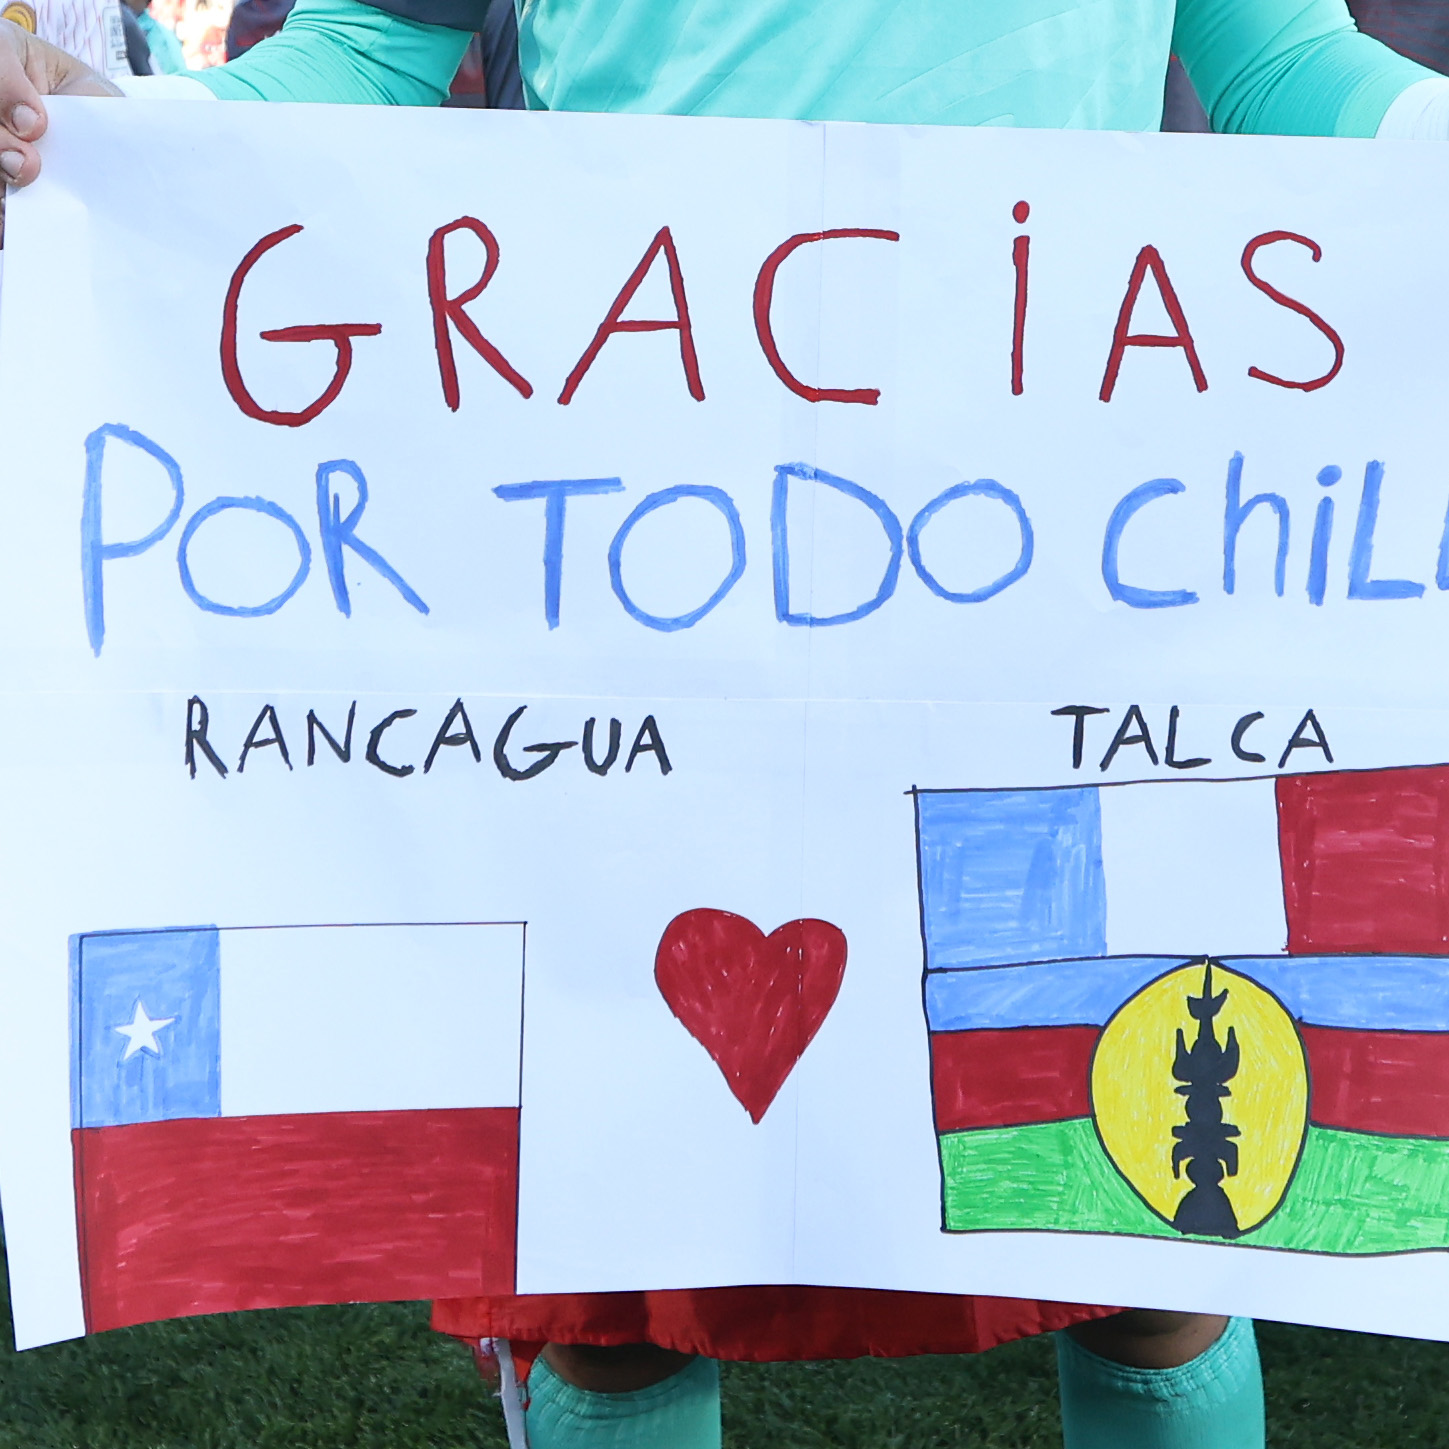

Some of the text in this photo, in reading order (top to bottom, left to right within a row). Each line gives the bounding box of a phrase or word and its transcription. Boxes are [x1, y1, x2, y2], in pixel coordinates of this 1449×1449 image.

[81, 423, 430, 657] POR
[492, 461, 1034, 632] TODO
[186, 696, 672, 781] RANCAGUA
[1051, 705, 1333, 771] TALCA
